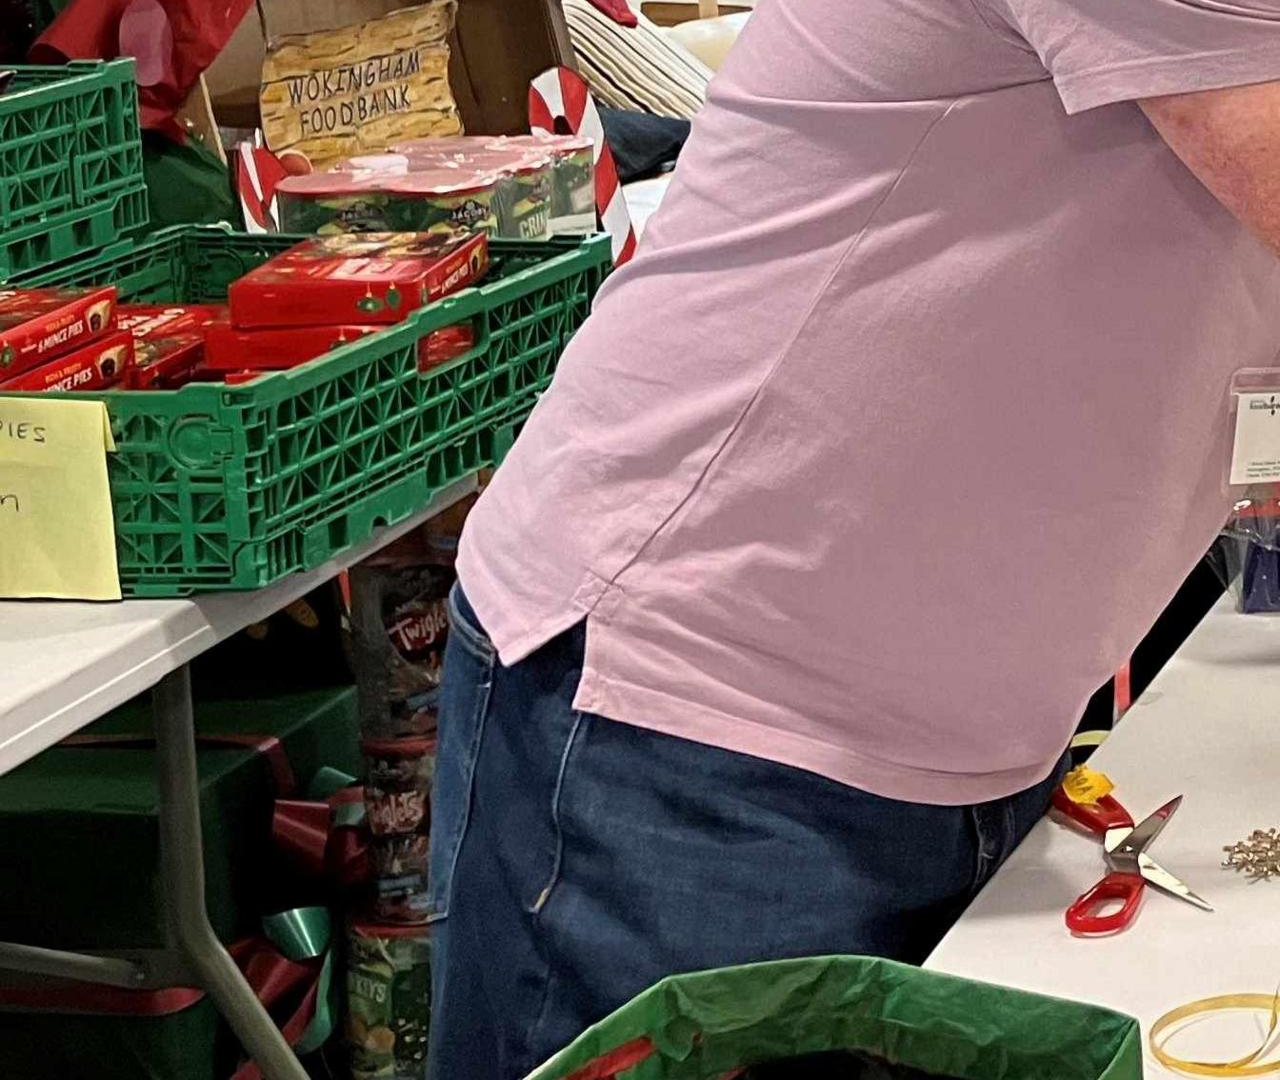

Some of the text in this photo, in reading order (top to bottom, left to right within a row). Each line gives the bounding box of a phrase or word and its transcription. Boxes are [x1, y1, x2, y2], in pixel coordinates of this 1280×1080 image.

[287, 49, 421, 107] WOKINGHAM
[300, 83, 411, 139] FOODBANK
[44, 328, 68, 351] MINCE
[68, 320, 83, 338] PIES
[73, 367, 92, 387] PIES
